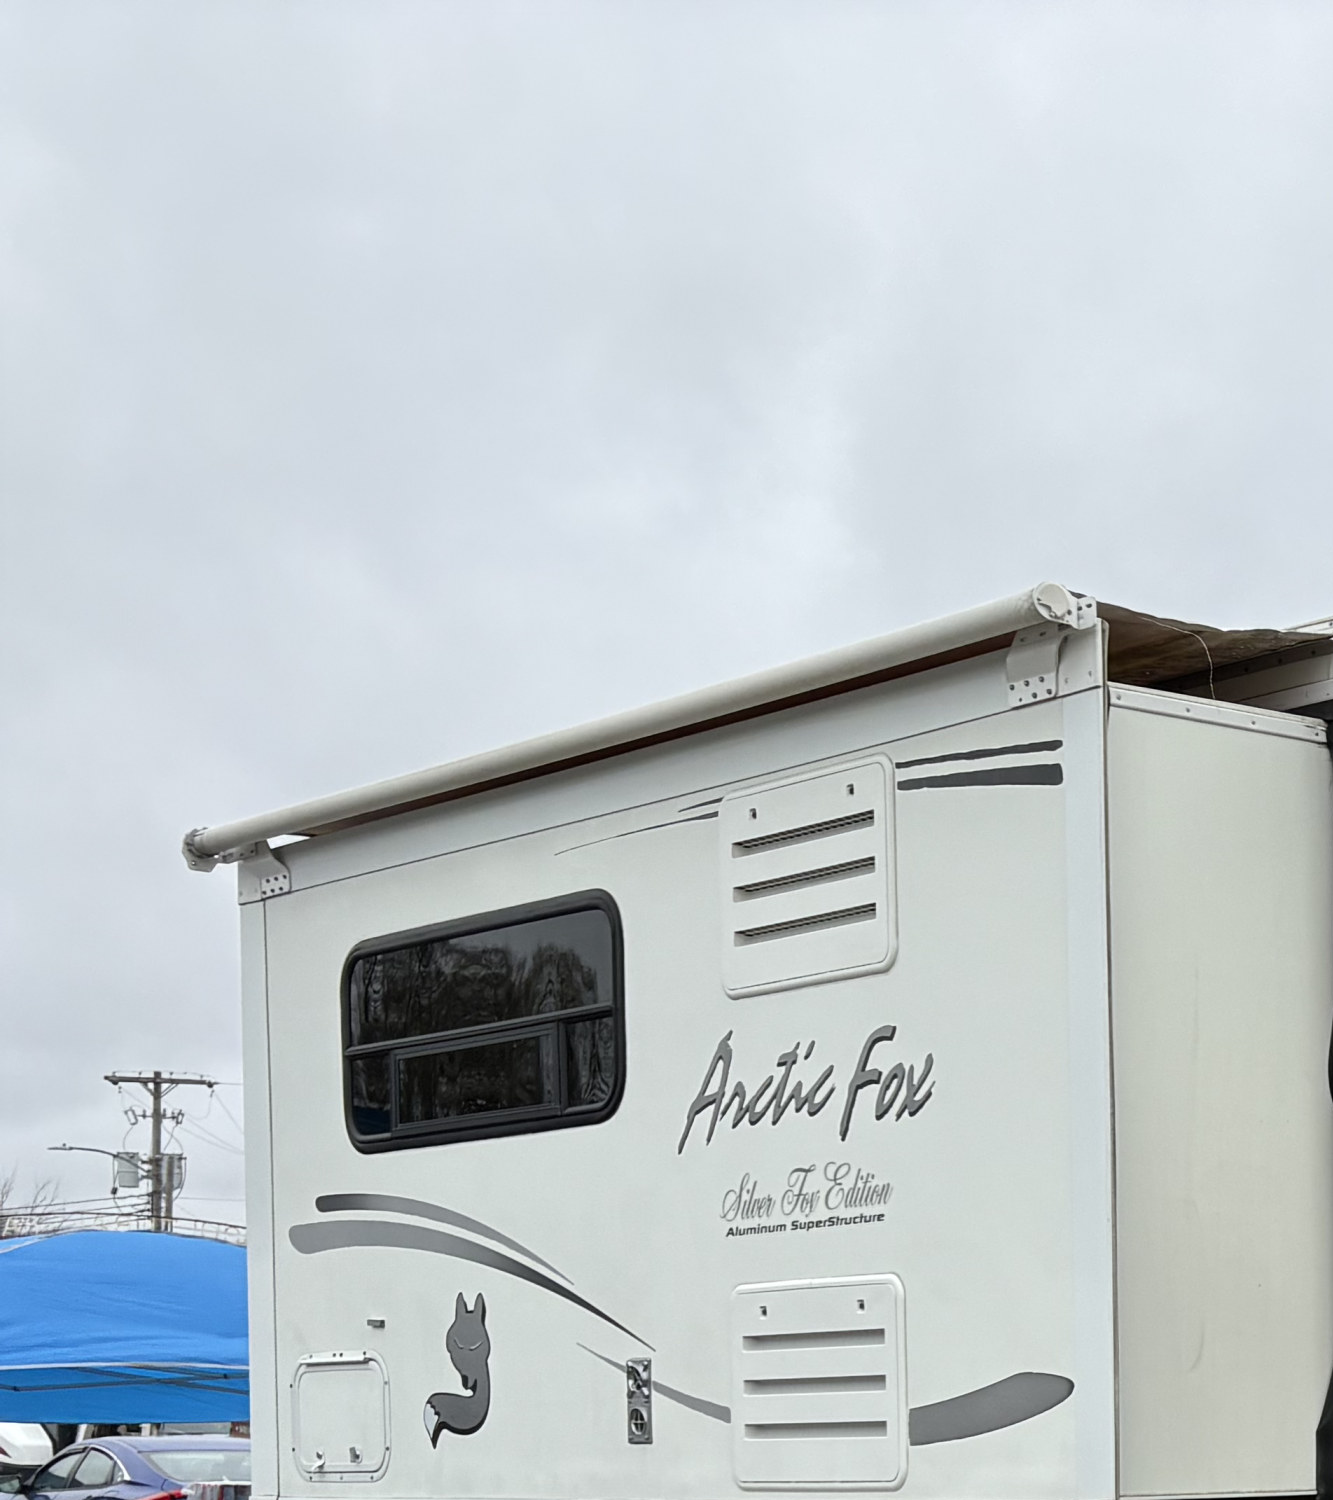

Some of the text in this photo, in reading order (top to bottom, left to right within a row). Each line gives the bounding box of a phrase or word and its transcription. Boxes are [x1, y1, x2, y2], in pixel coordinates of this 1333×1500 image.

[677, 1024, 936, 1155] Arctic Fox
[720, 1161, 893, 1222] Silver Fox Edition
[726, 1212, 885, 1238] Aluminum SuperStructure
